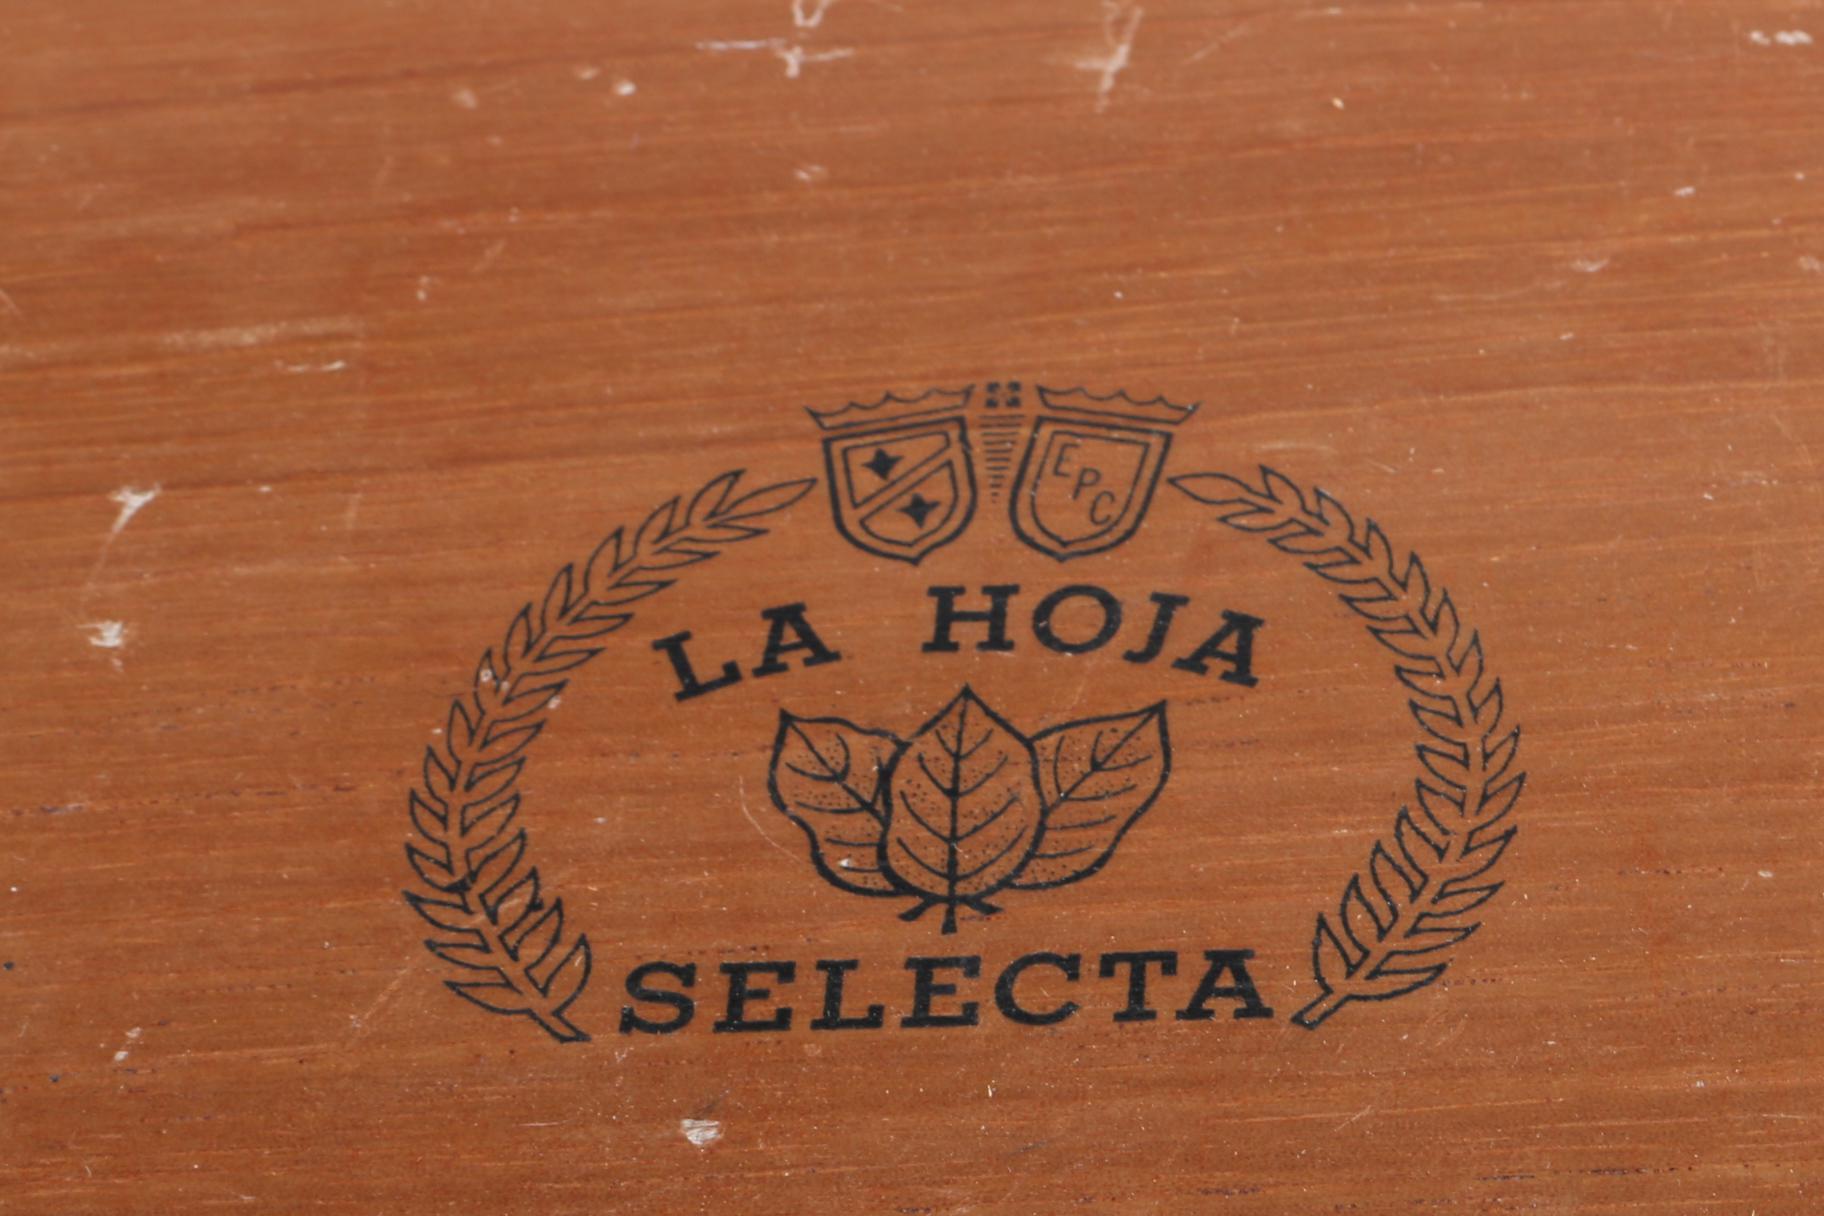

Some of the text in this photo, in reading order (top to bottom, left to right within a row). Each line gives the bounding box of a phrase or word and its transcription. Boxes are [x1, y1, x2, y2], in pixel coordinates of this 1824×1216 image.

[1053, 443, 1116, 526] EPC
[652, 584, 1264, 702] LA HOJA
[617, 949, 1273, 1035] SELECTA
